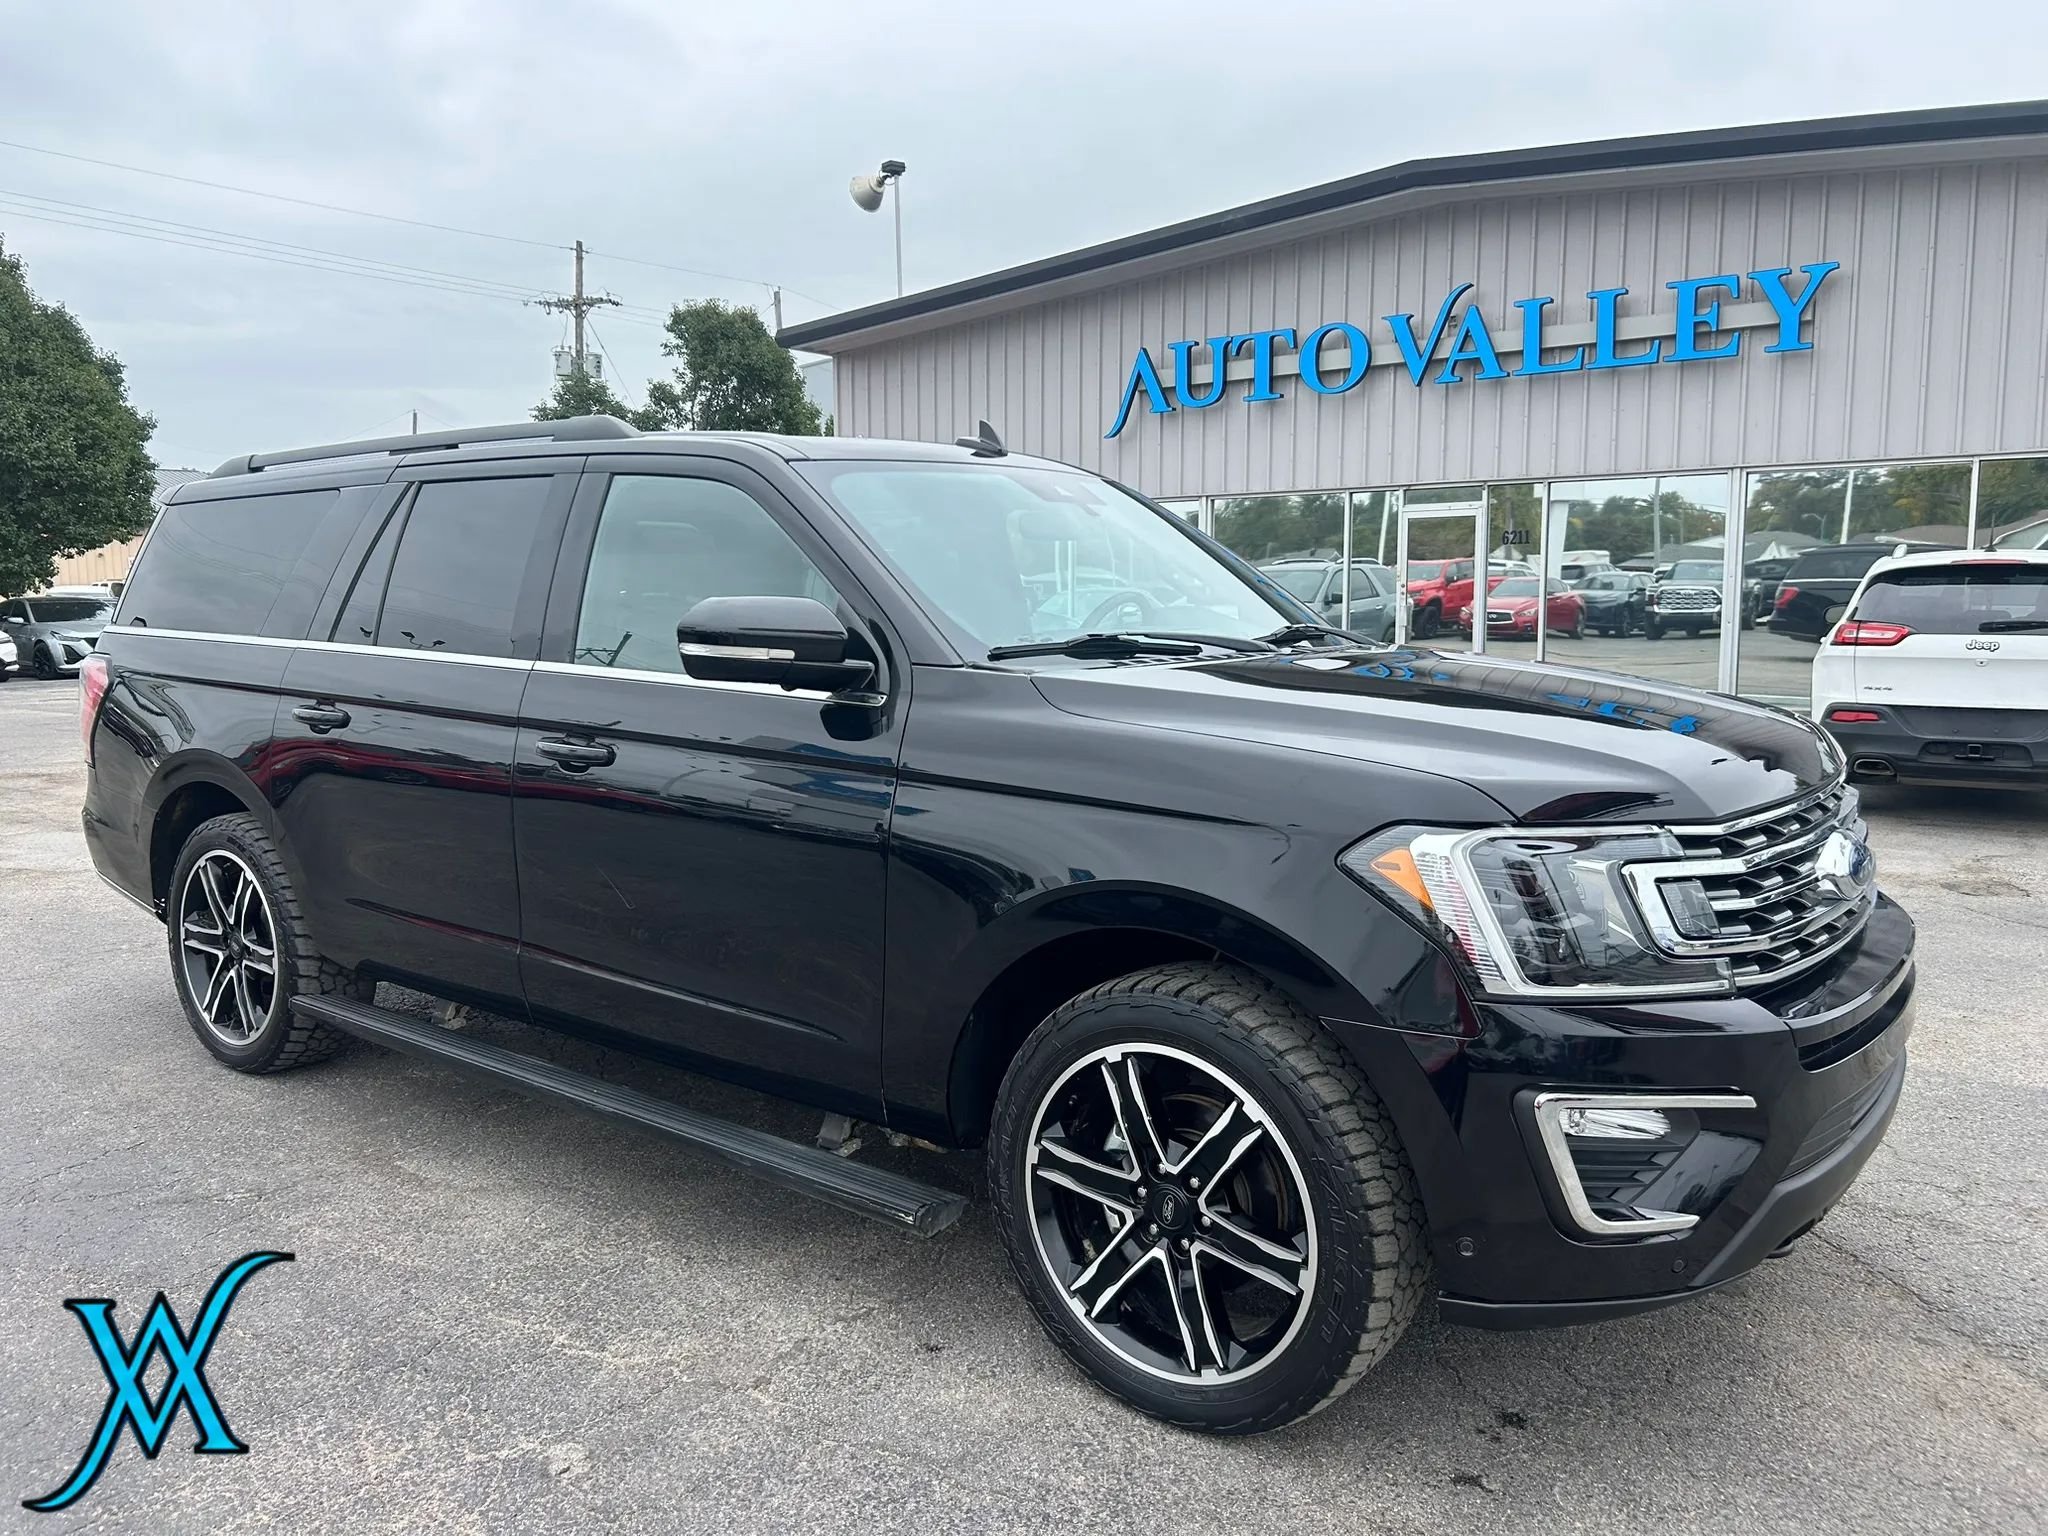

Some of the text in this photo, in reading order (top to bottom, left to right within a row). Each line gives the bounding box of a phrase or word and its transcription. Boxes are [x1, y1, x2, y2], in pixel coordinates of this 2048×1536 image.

[1104, 260, 1841, 440] AUTO VALLEY
[1502, 529, 1531, 546] 6211
[1965, 639, 2001, 653] Jeep
